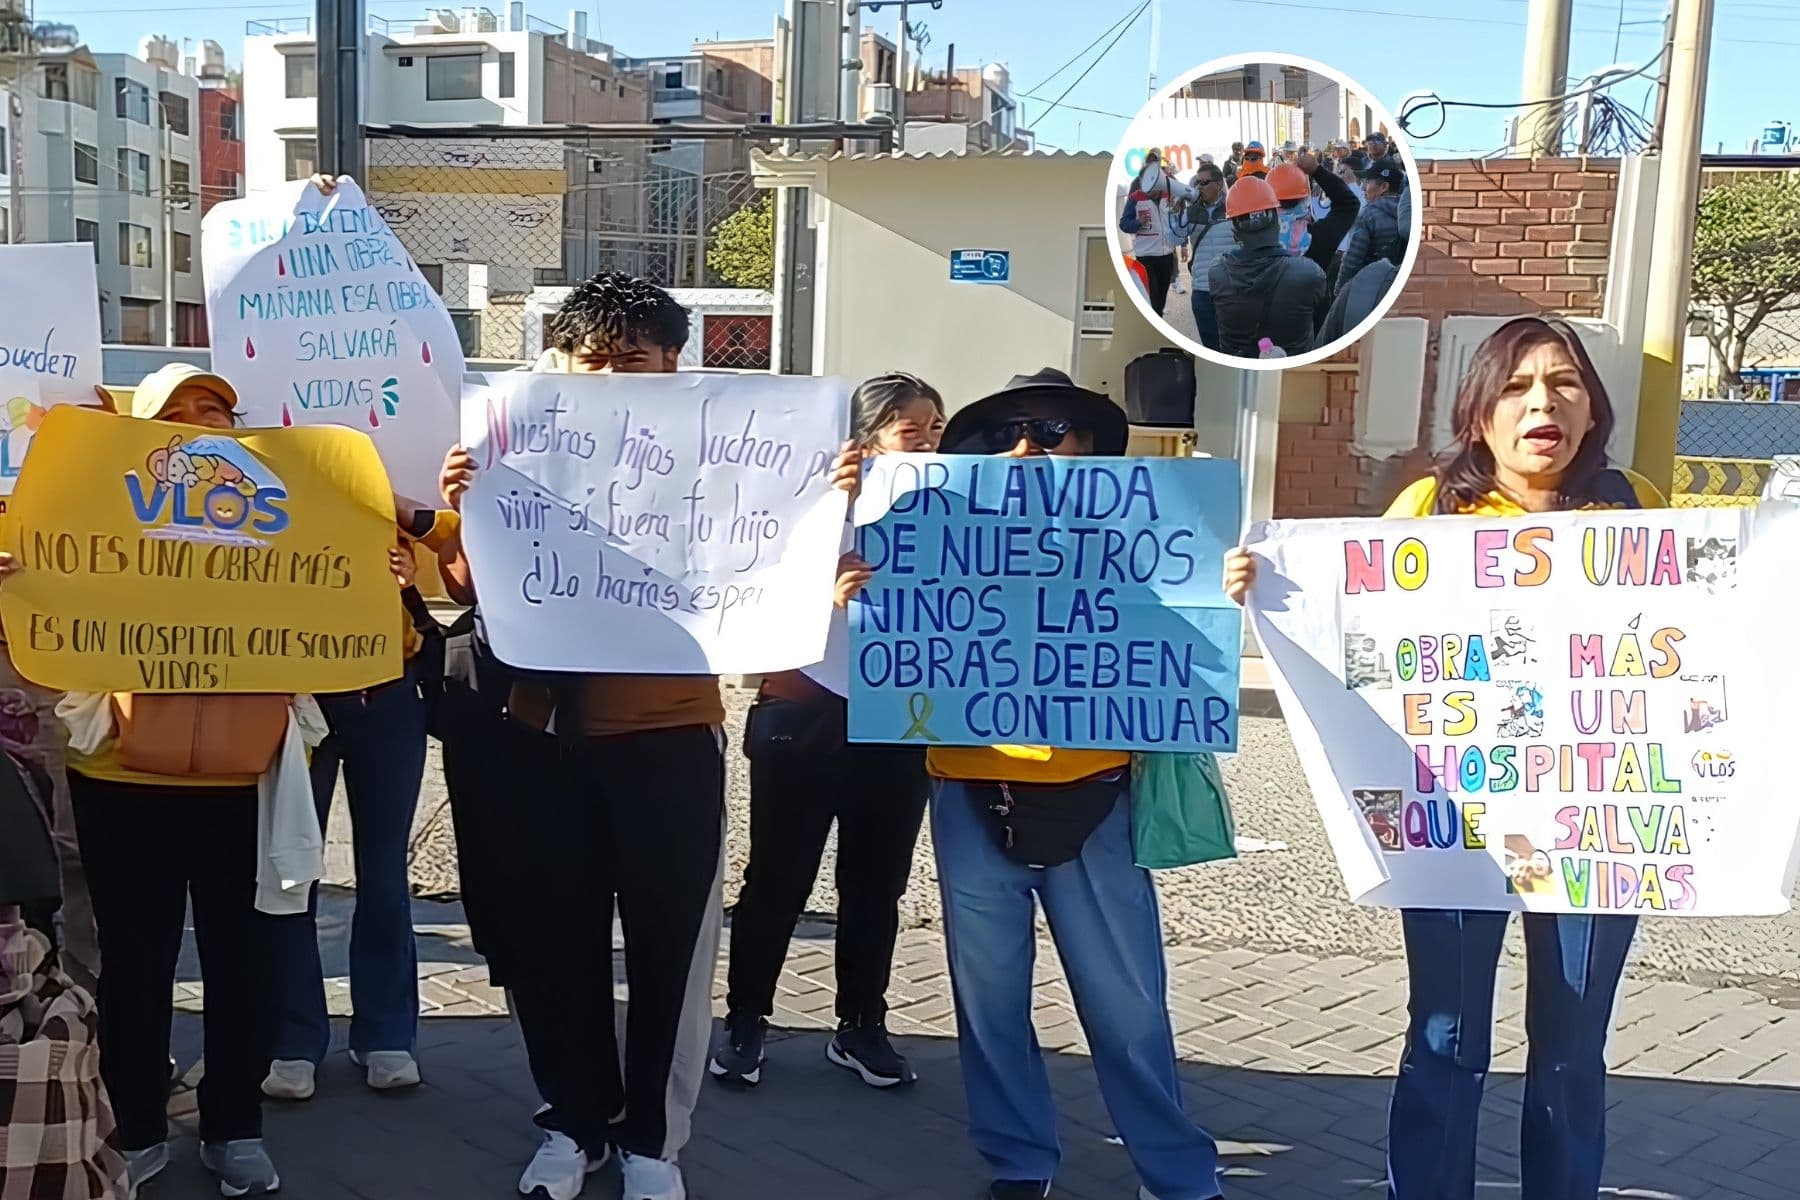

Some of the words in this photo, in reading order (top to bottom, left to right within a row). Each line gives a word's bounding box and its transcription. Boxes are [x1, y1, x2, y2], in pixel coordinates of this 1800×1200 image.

[289, 242, 340, 279] UNA
[239, 284, 336, 321] MAÑANA
[341, 283, 382, 313] ESA
[298, 320, 397, 361] SALVARÁ
[293, 378, 374, 409] VIDAS
[485, 392, 597, 471] Nuestros
[612, 408, 676, 490] hijos
[698, 398, 792, 477] luchan
[124, 468, 290, 534] VLOS
[878, 461, 952, 517] OR
[967, 462, 1028, 518] LA
[1034, 464, 1160, 522] VIDA
[496, 489, 553, 532] vivir
[607, 480, 671, 543] fuera
[681, 478, 713, 545] tu
[728, 482, 780, 572] hijo
[89, 534, 129, 574] ES
[138, 537, 193, 579] UNA
[204, 544, 279, 584] OBRA
[289, 545, 351, 589] MÁS
[522, 540, 580, 605] ¿Lo
[858, 523, 916, 575] DE
[940, 523, 1195, 585] NUESTROS
[1343, 536, 1430, 595] NO
[1474, 526, 1554, 589] ES
[1580, 526, 1682, 587] UNA
[858, 577, 1008, 637] NIÑOS
[1036, 585, 1119, 634] LAS
[30, 612, 64, 651] ES
[72, 618, 107, 653] UN
[119, 621, 239, 658] HOSPITAL
[247, 626, 293, 657] QUE
[1395, 634, 1492, 683] OBRA
[1569, 612, 1687, 679] MÁS
[858, 636, 1020, 690] OBRAS
[1032, 640, 1194, 690] DEBEN
[964, 690, 1231, 745] CONTINUAR
[1402, 690, 1478, 737] ES
[1570, 689, 1649, 736] UN
[1414, 741, 1682, 794] HOSPITAL
[1404, 799, 1487, 850] QUE
[1554, 804, 1692, 855] SALVA
[1560, 856, 1697, 911] VIDAS
